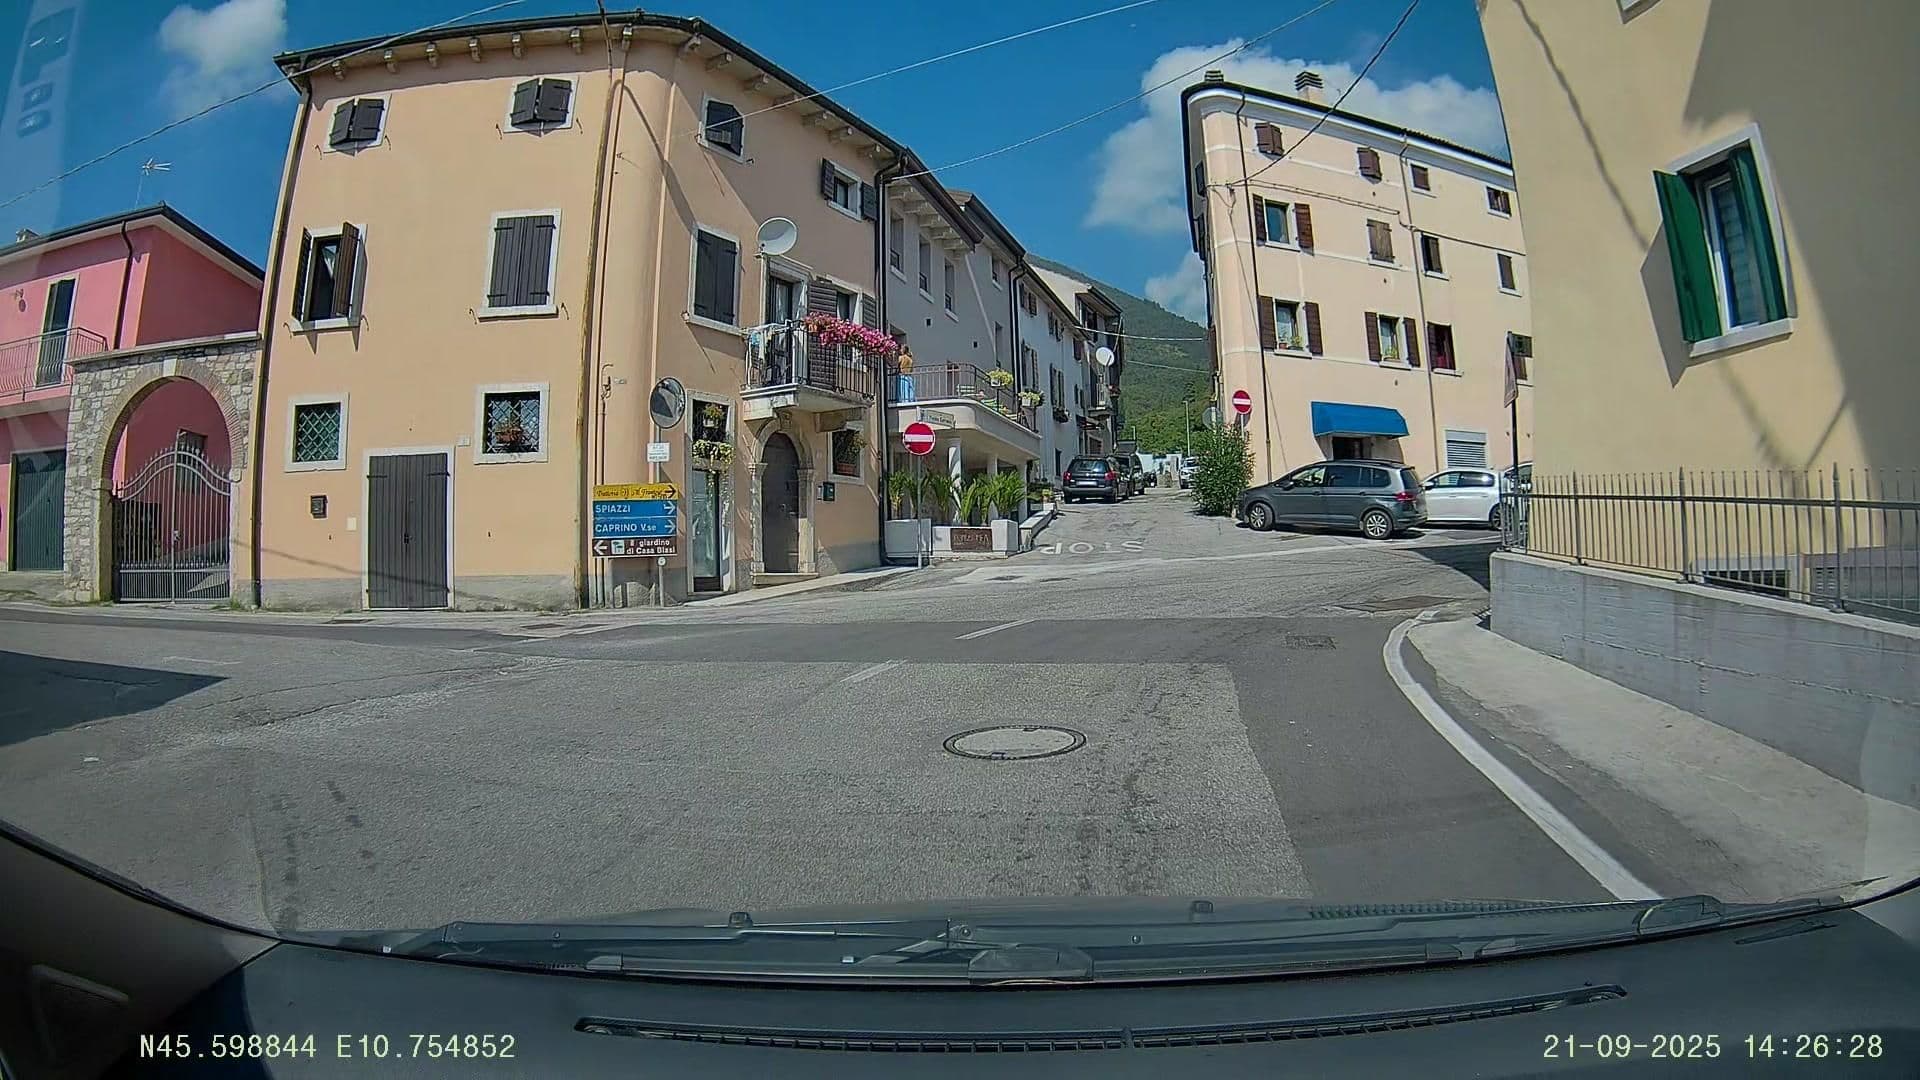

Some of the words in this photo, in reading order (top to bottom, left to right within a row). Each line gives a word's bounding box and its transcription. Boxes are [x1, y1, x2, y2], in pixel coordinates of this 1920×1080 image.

[595, 504, 631, 513] SPIAZZI
[595, 523, 638, 532] CAPRINO
[640, 523, 657, 531] V.se
[639, 539, 670, 548] giardino
[1040, 540, 1145, 554] STOP
[626, 547, 634, 555] di
